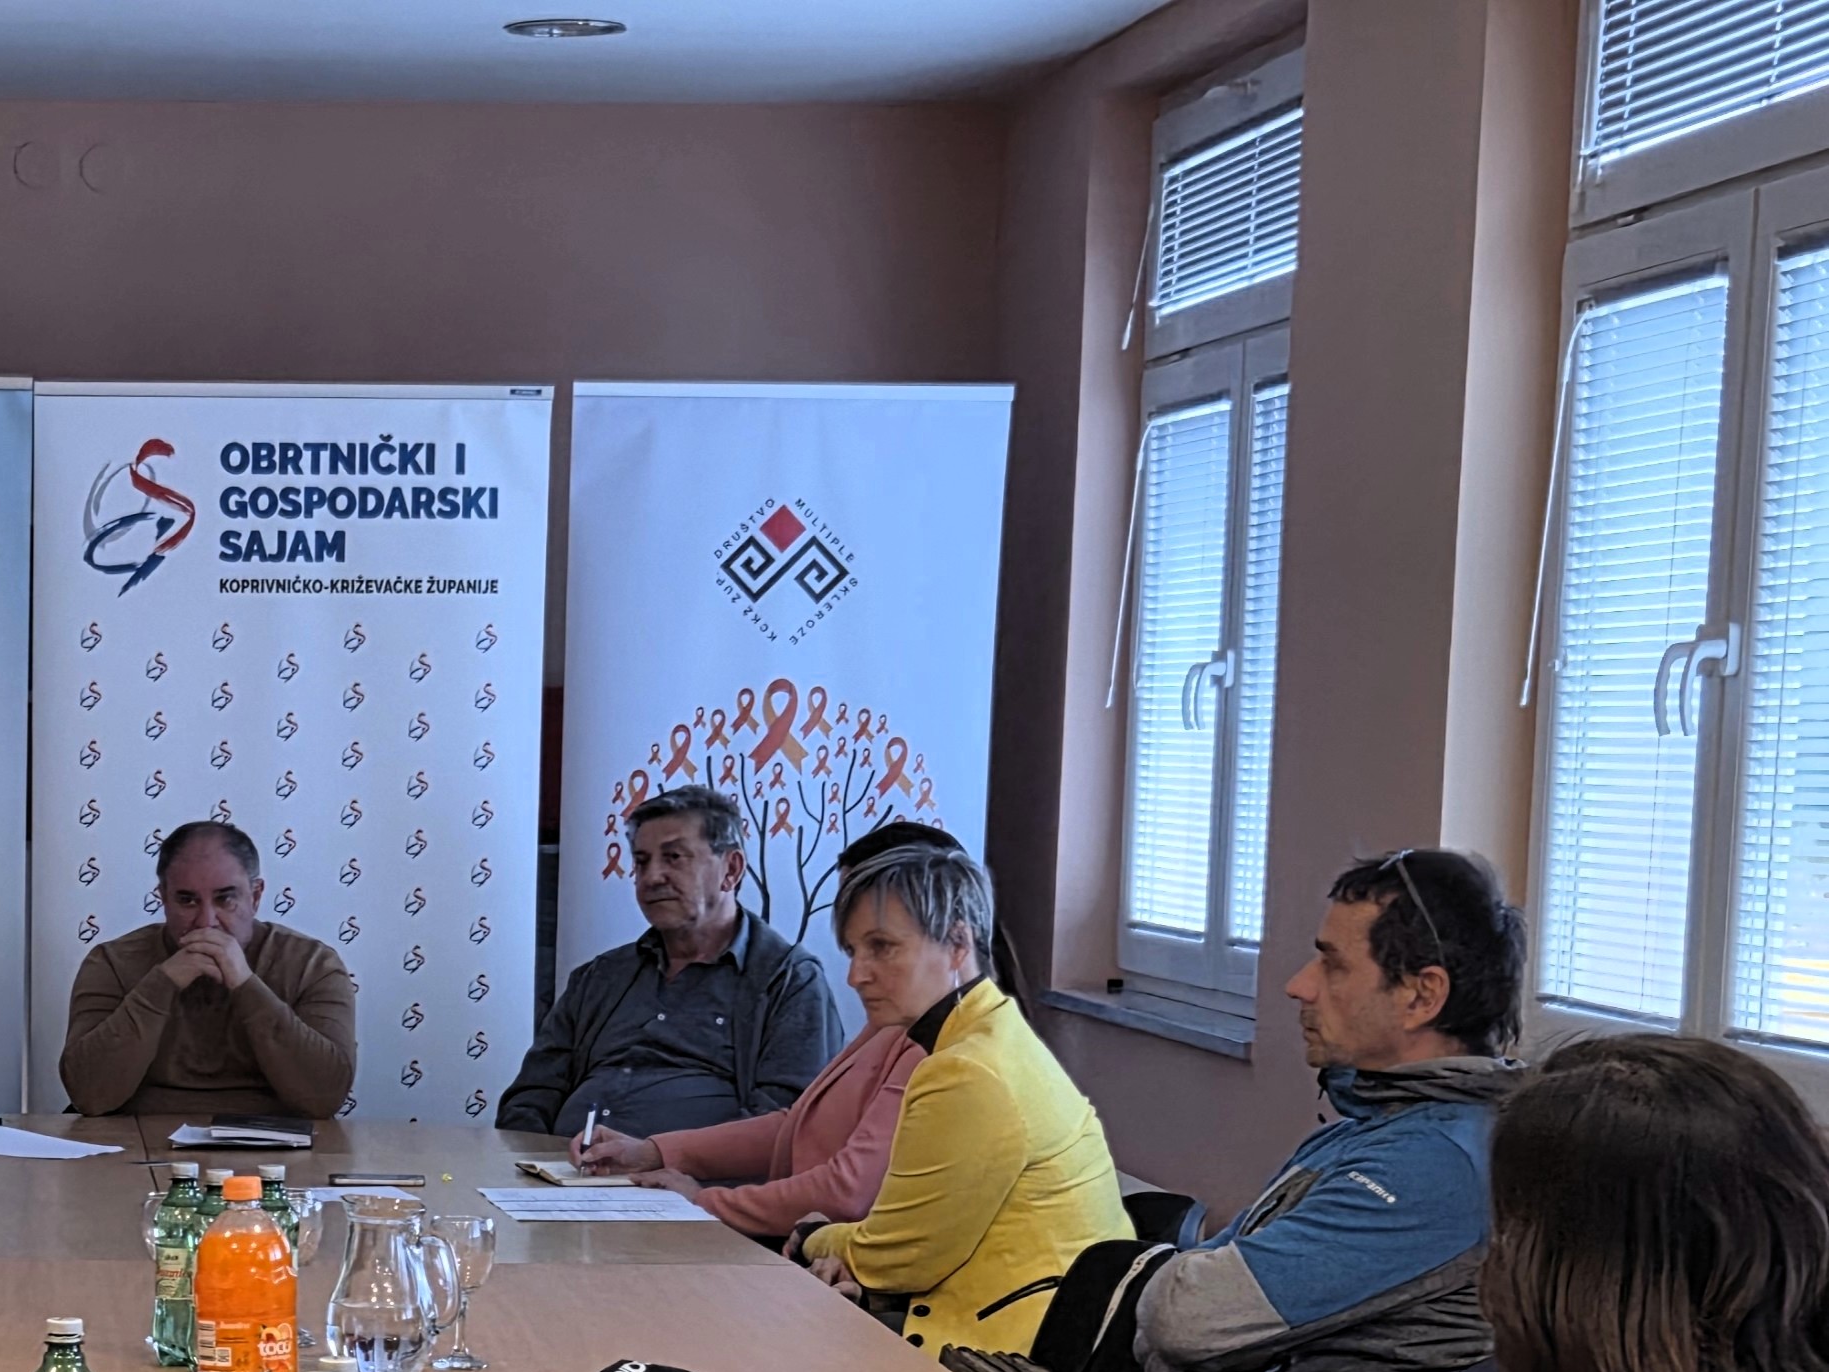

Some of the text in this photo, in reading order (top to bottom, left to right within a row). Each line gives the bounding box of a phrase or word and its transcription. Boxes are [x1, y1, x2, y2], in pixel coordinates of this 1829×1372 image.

[219, 433, 467, 475] OBRTNIČKI I
[219, 486, 500, 520] GOSPODARSKI
[218, 530, 347, 564] SAJAM
[794, 498, 855, 563] MULTIPLE
[219, 576, 499, 595] KOPRIVNIČKO-KRIŽEVAČKE ŽUPANIJE
[789, 577, 859, 646] SKLEROZE
